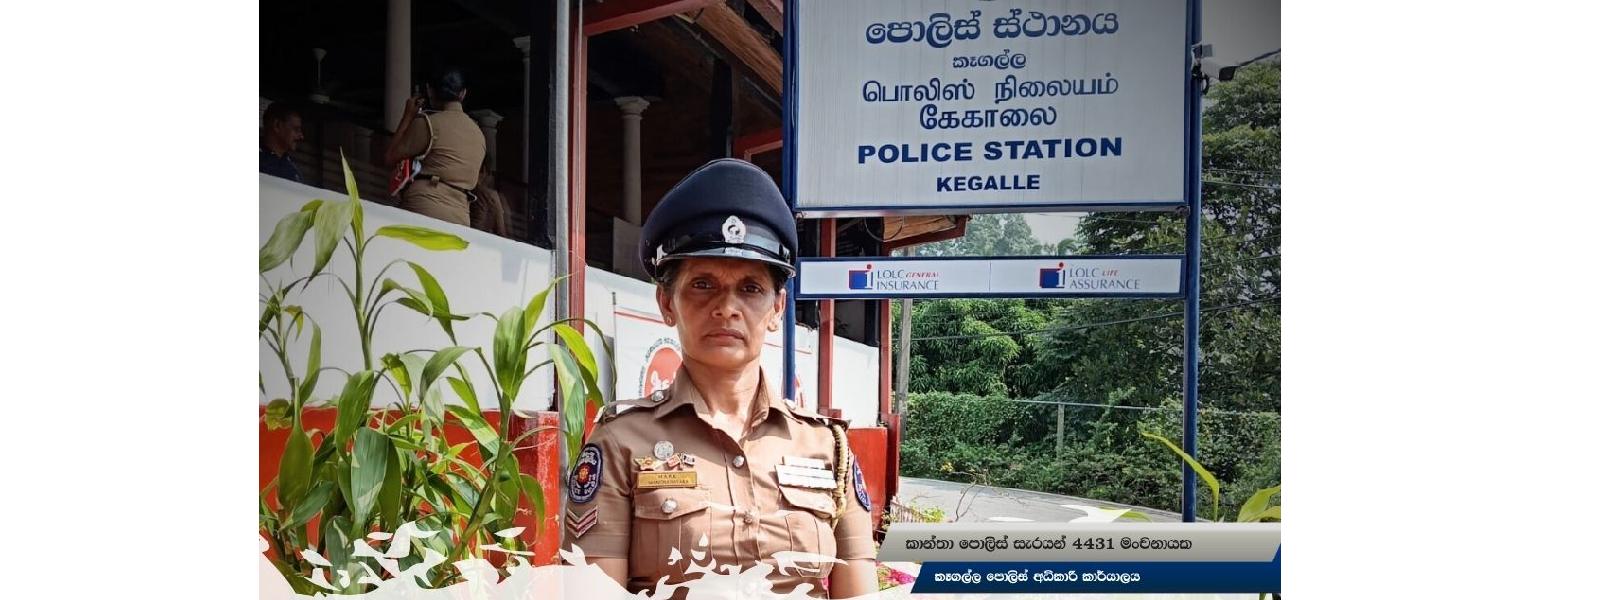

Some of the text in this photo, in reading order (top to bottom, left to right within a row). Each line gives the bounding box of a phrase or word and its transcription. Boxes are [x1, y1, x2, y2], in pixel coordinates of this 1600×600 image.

[866, 9, 1119, 48] පොලිස් ස්ථානය
[863, 72, 1118, 104] பொலிஸ் நிலையம்
[920, 103, 1057, 129] கேகாலை
[859, 137, 1121, 163] POLICE STATION
[937, 175, 1040, 192] KEGALLE
[878, 270, 904, 279] LOLC
[1070, 268, 1098, 277] LOLC
[877, 280, 939, 290] INSURANCE
[1070, 279, 1140, 289] ASSURANCE
